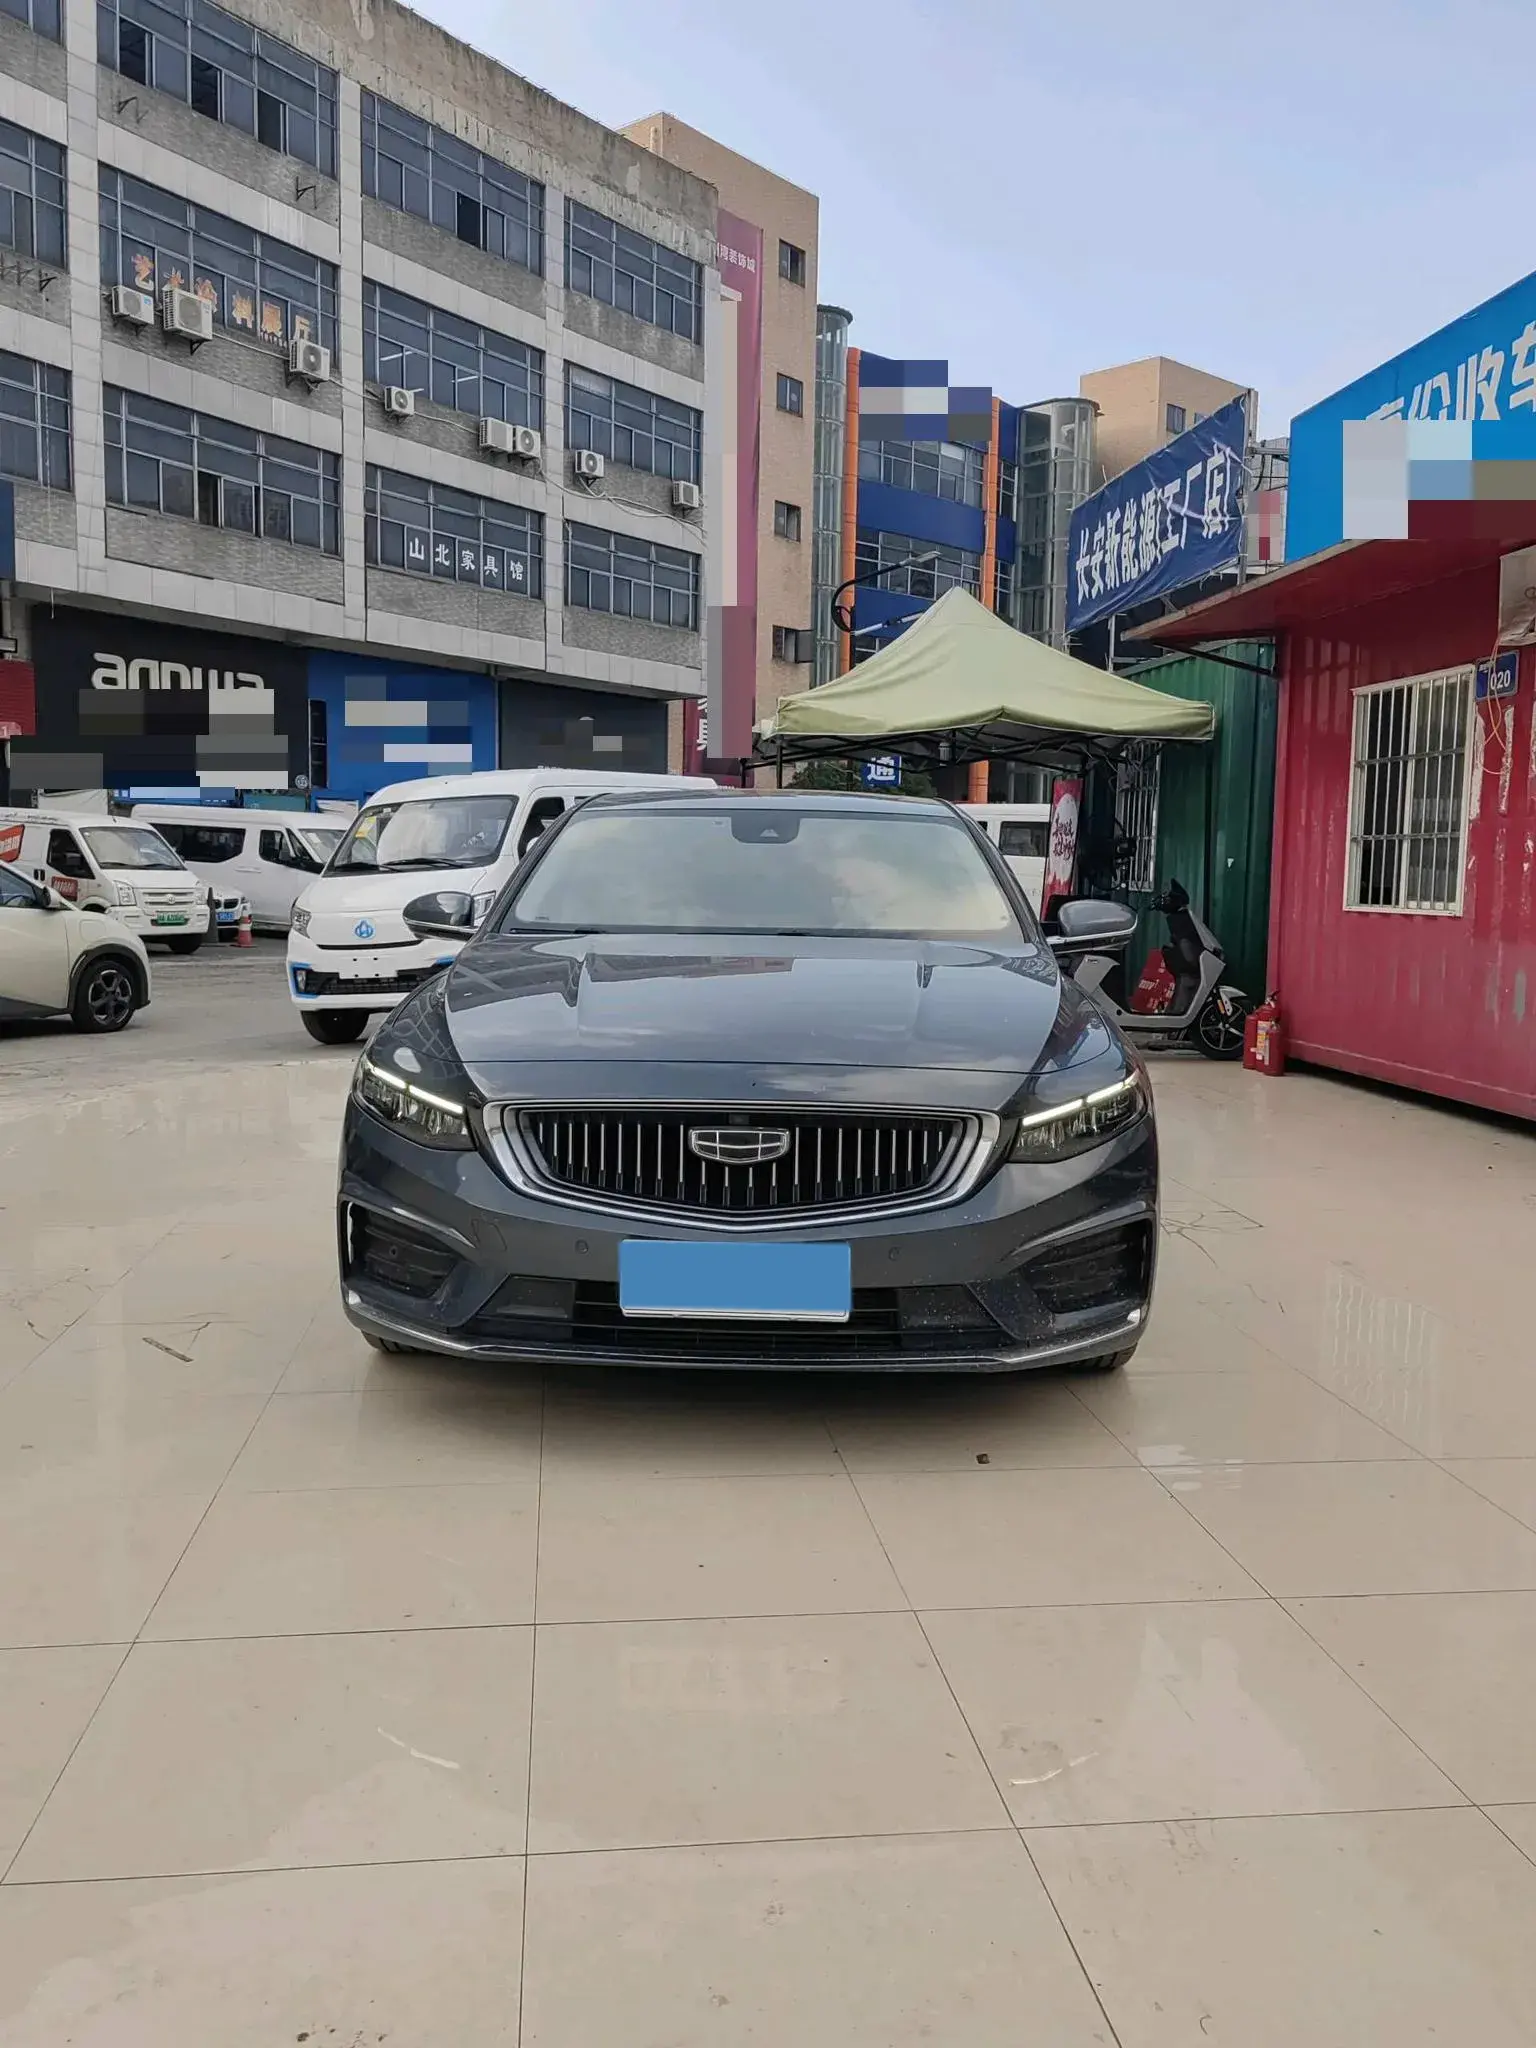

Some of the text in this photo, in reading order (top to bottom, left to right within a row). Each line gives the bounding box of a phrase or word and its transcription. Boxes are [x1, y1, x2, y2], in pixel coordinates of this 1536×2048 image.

[409, 537, 524, 580] 山北家具馆
